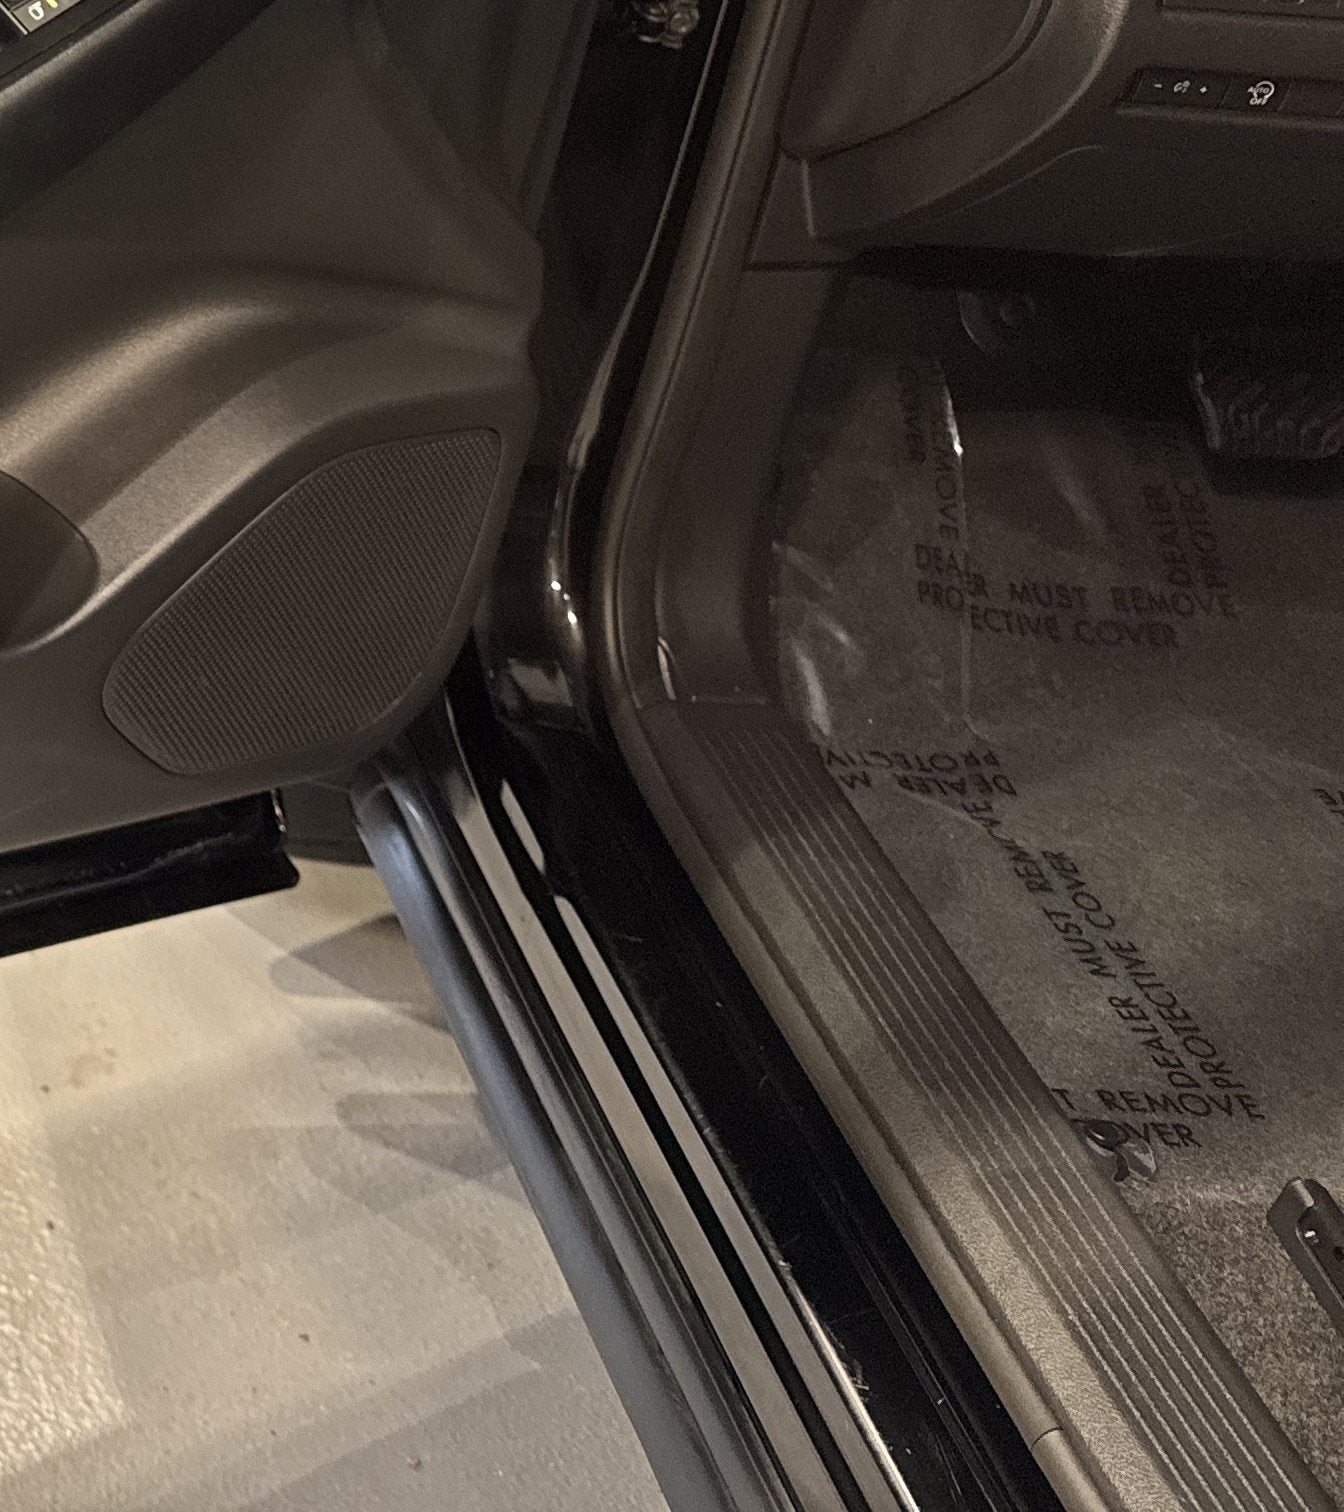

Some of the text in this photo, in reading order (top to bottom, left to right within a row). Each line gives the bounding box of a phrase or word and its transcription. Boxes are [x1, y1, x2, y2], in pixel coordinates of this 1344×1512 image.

[1249, 97, 1269, 106] OFF
[1173, 479, 1229, 590] PROTEC
[916, 580, 1178, 649] PROECTIVE COVER
[1009, 581, 1088, 609] MUST
[1110, 585, 1238, 621] REMOVE
[825, 749, 1001, 773] PROTECTIV
[892, 772, 1018, 797] DEALER
[1041, 849, 1246, 1090] PROTECTIVE COVER
[1042, 906, 1118, 979] MUST
[1106, 995, 1202, 1088] DEALER
[1094, 1088, 1266, 1121] REMOVE
